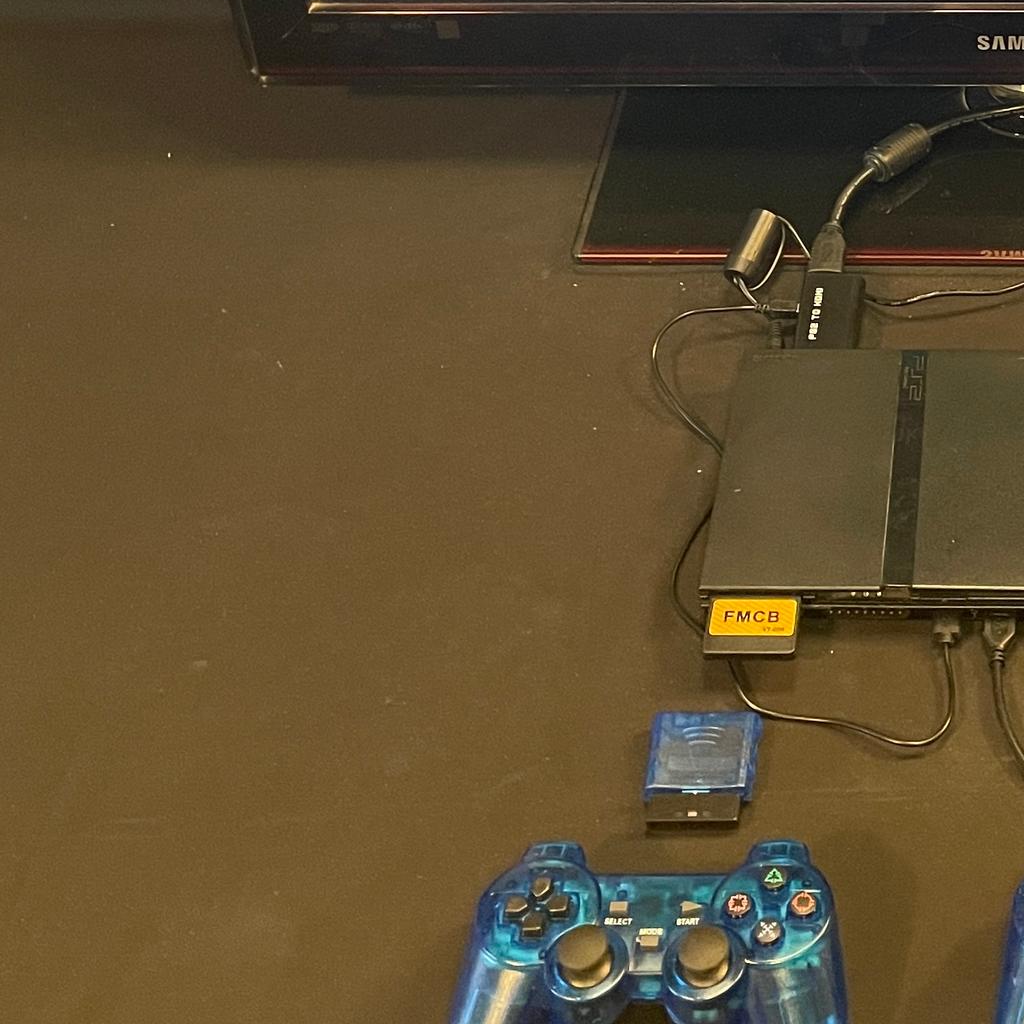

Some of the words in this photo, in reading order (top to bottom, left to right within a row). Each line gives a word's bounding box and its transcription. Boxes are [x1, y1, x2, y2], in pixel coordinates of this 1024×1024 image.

[723, 610, 780, 624] FMCB
[603, 917, 633, 926] SELECT
[676, 917, 700, 926] START
